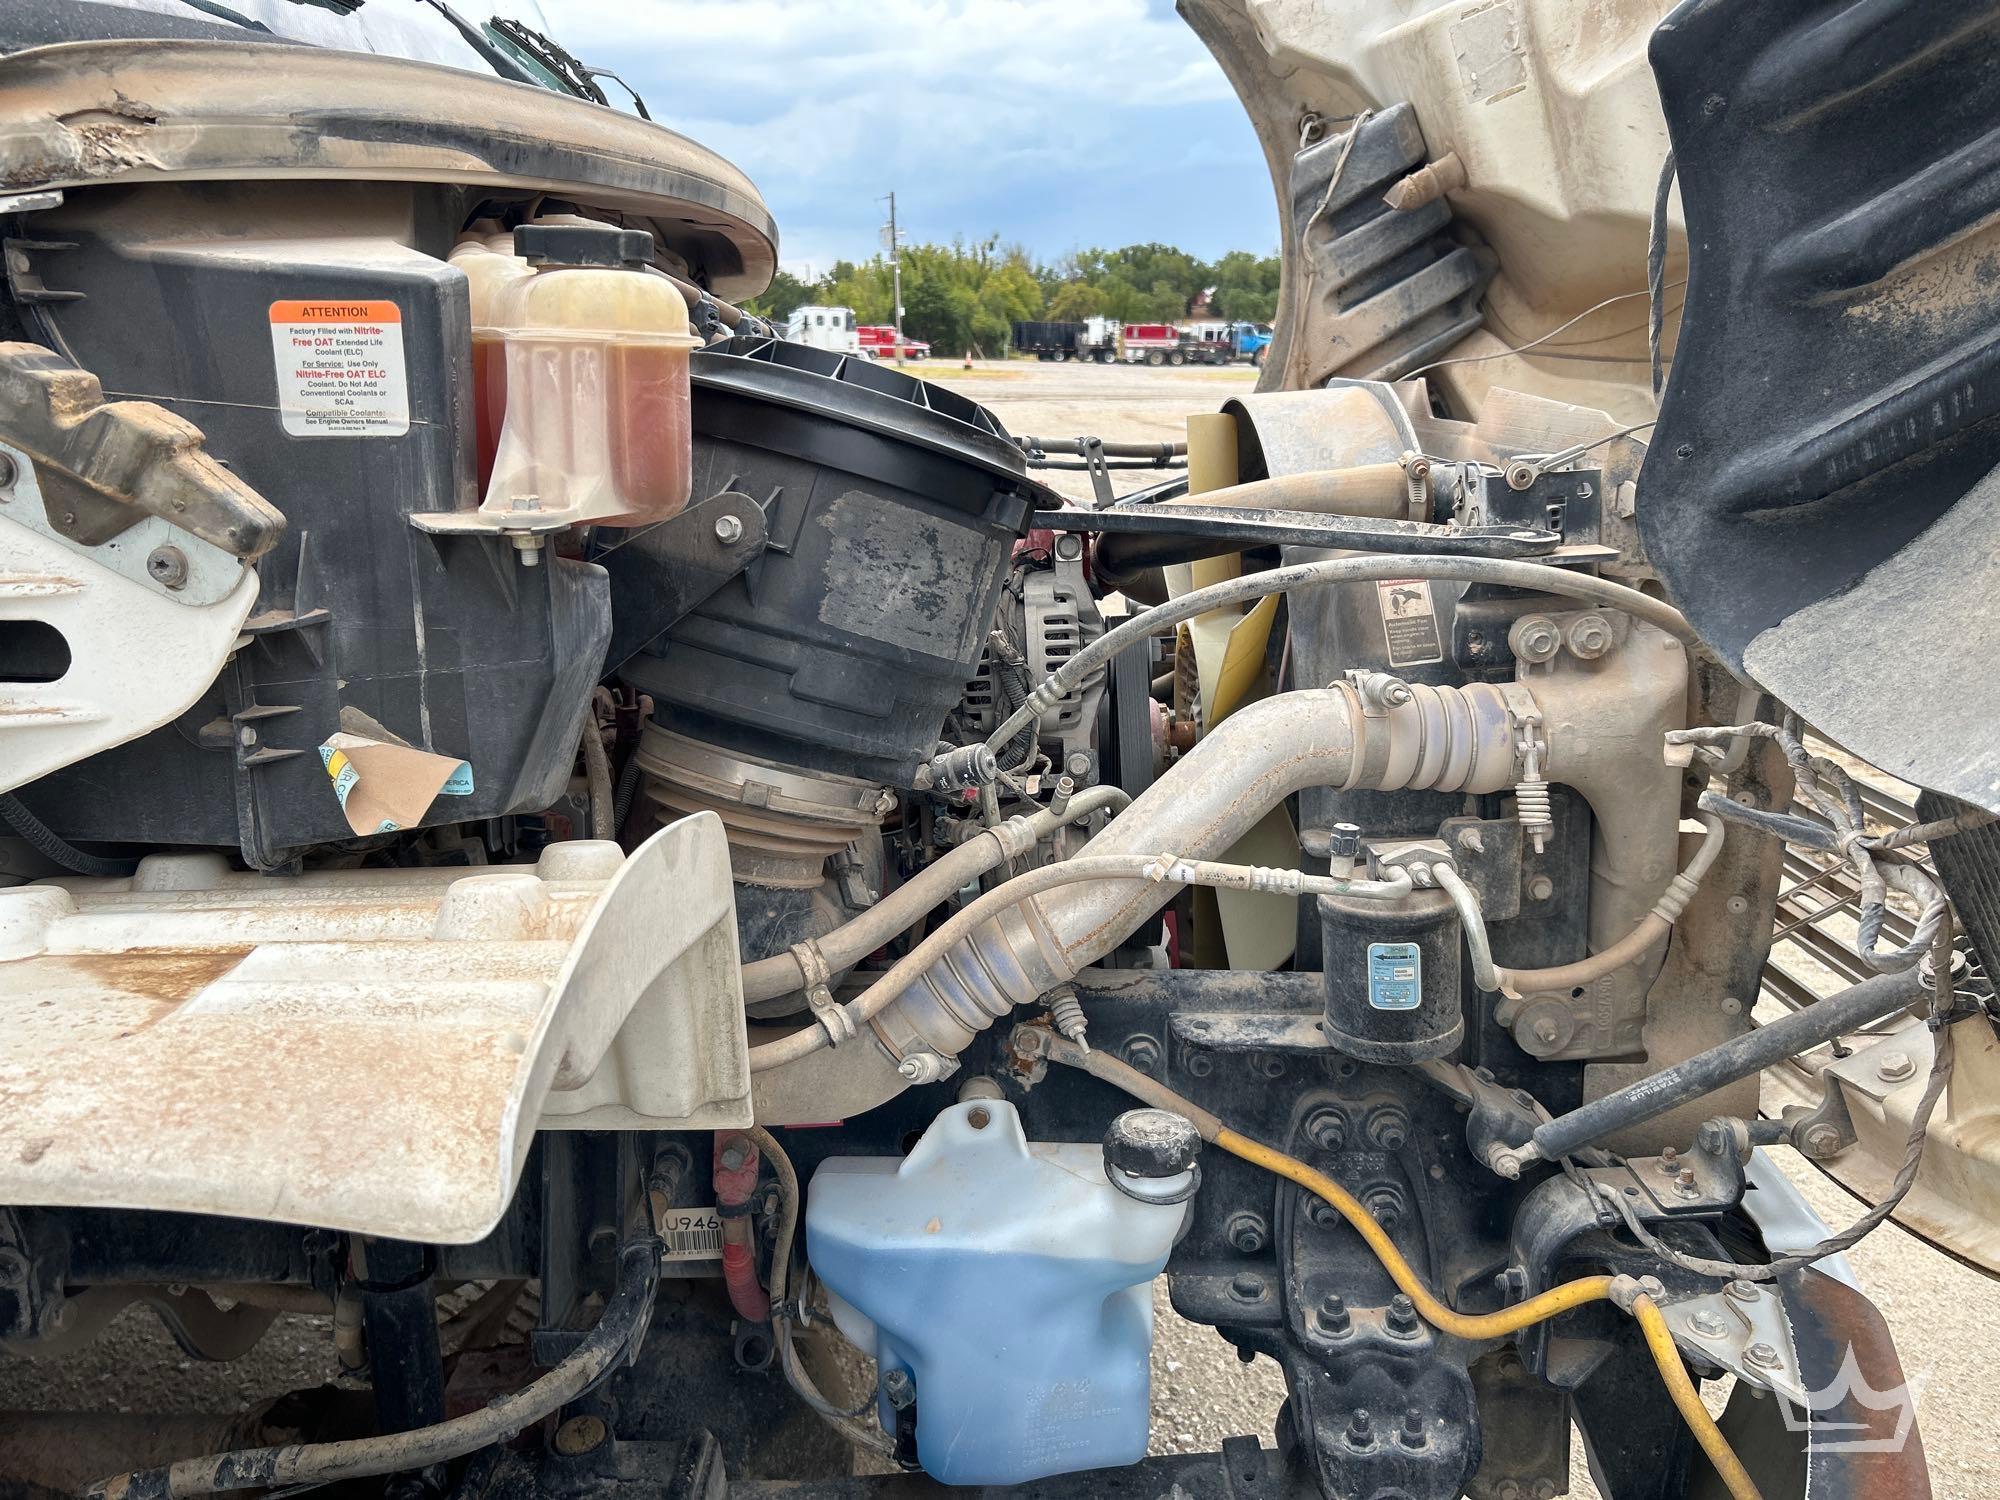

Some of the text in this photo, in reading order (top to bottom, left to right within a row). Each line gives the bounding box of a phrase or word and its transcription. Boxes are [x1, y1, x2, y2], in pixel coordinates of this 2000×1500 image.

[302, 307, 368, 317] ATTENTION
[290, 328, 316, 337] Factory
[338, 327, 353, 335] with
[354, 326, 384, 335] Nitrite-
[292, 338, 312, 346] Free
[314, 338, 334, 346] OAT
[343, 348, 364, 356] (ELC)
[363, 361, 378, 369] Only
[295, 370, 386, 378] Nitrite-Free OAT ELC
[349, 409, 386, 417] Coolants:
[1630, 1076, 1681, 1102] STABILUS
[666, 1215, 724, 1231] U946
